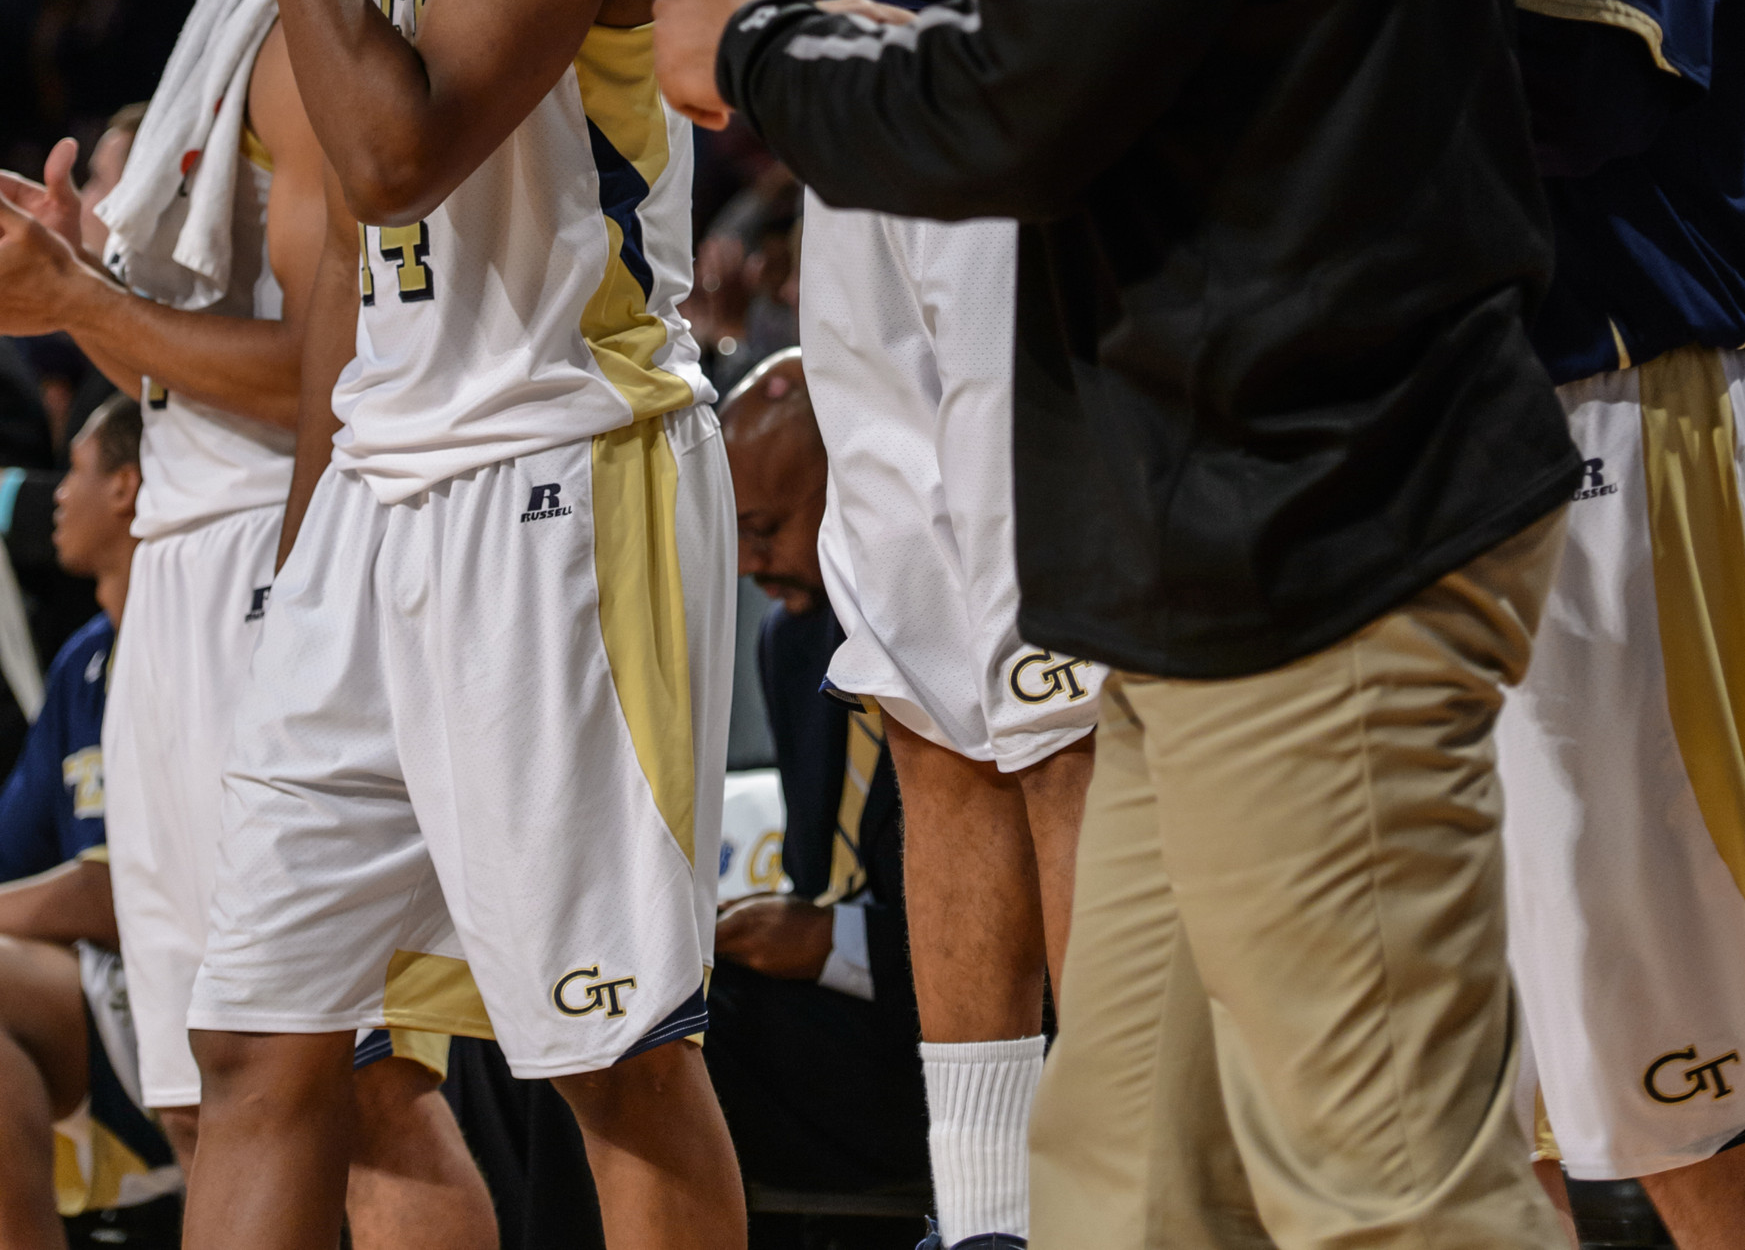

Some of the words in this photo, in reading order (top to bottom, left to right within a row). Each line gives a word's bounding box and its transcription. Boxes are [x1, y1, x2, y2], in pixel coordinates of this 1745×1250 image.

[520, 505, 573, 523] RUSSELL
[1572, 482, 1618, 501] USSELL
[1008, 649, 1094, 705] GT
[552, 964, 637, 1019] GT
[1641, 1044, 1741, 1105] GT
